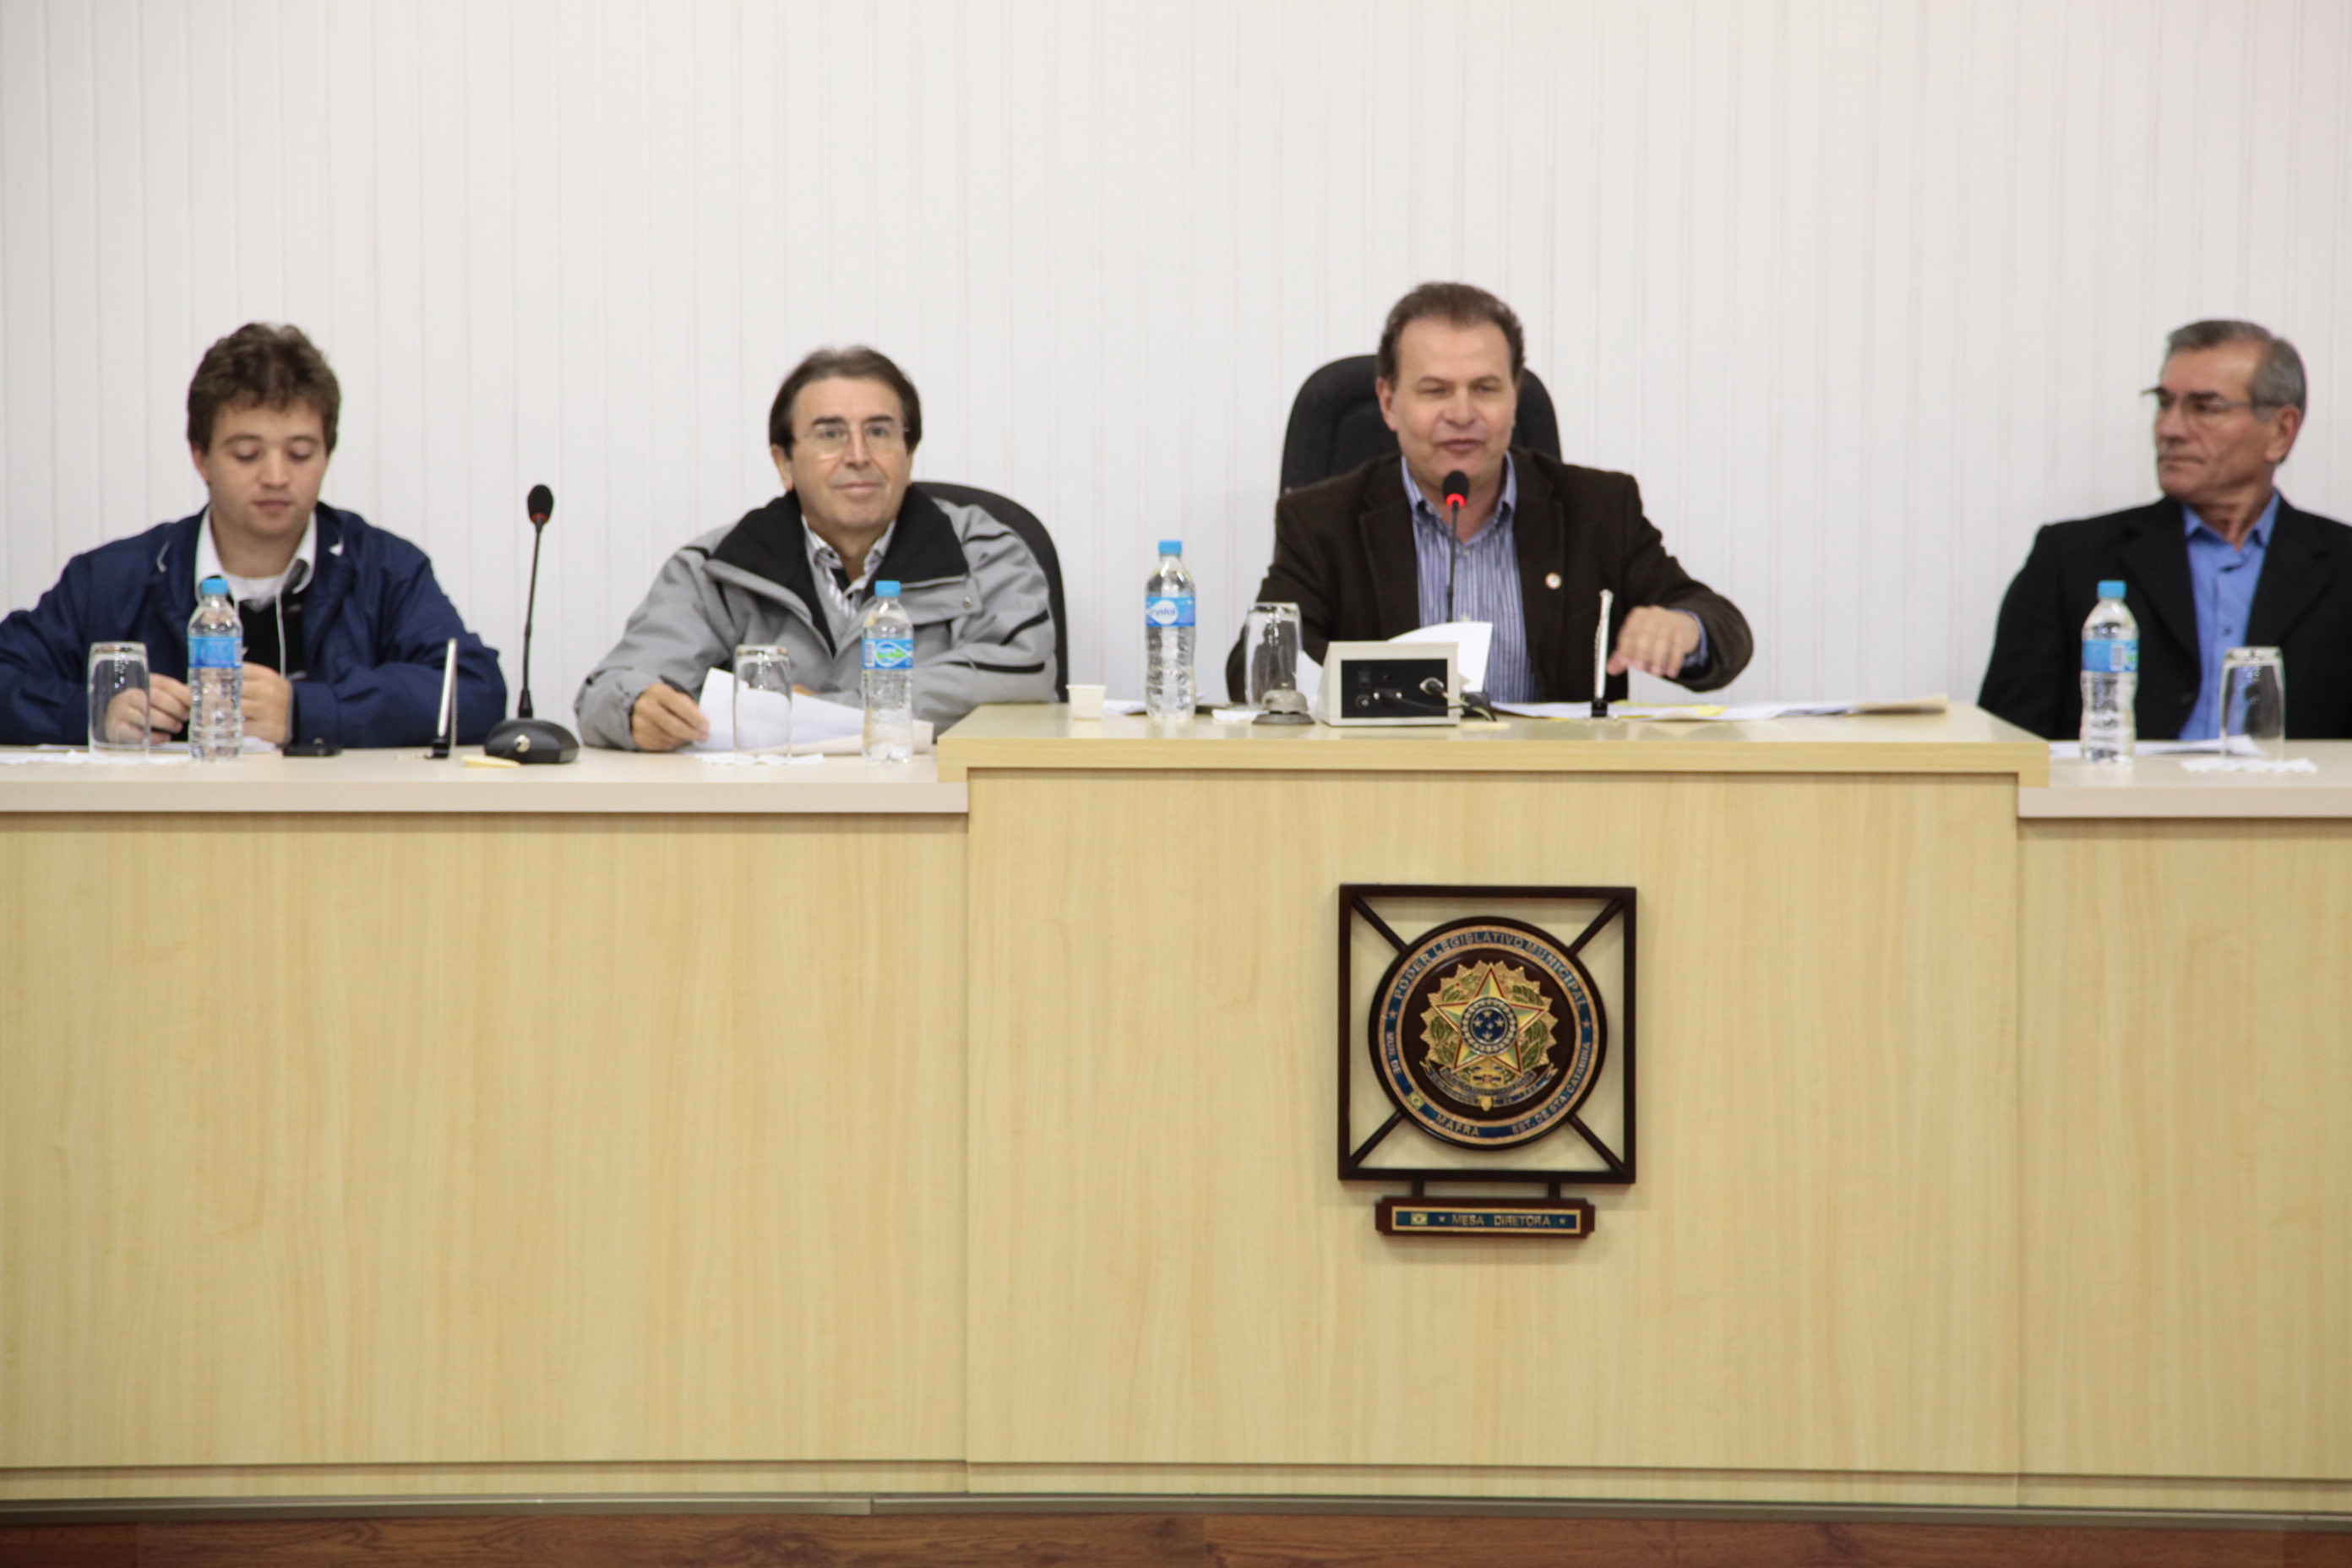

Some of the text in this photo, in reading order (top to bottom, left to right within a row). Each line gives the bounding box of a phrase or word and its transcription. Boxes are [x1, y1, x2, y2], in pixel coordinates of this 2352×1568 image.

[1393, 931, 1587, 1007] PODER LEGISLATIVO MUNICIPAL
[1391, 1059, 1402, 1075] DE
[1436, 1113, 1479, 1137] MAFRA
[1566, 1042, 1591, 1093] CATARINA
[1451, 1214, 1551, 1227] MESA DIRETORA
